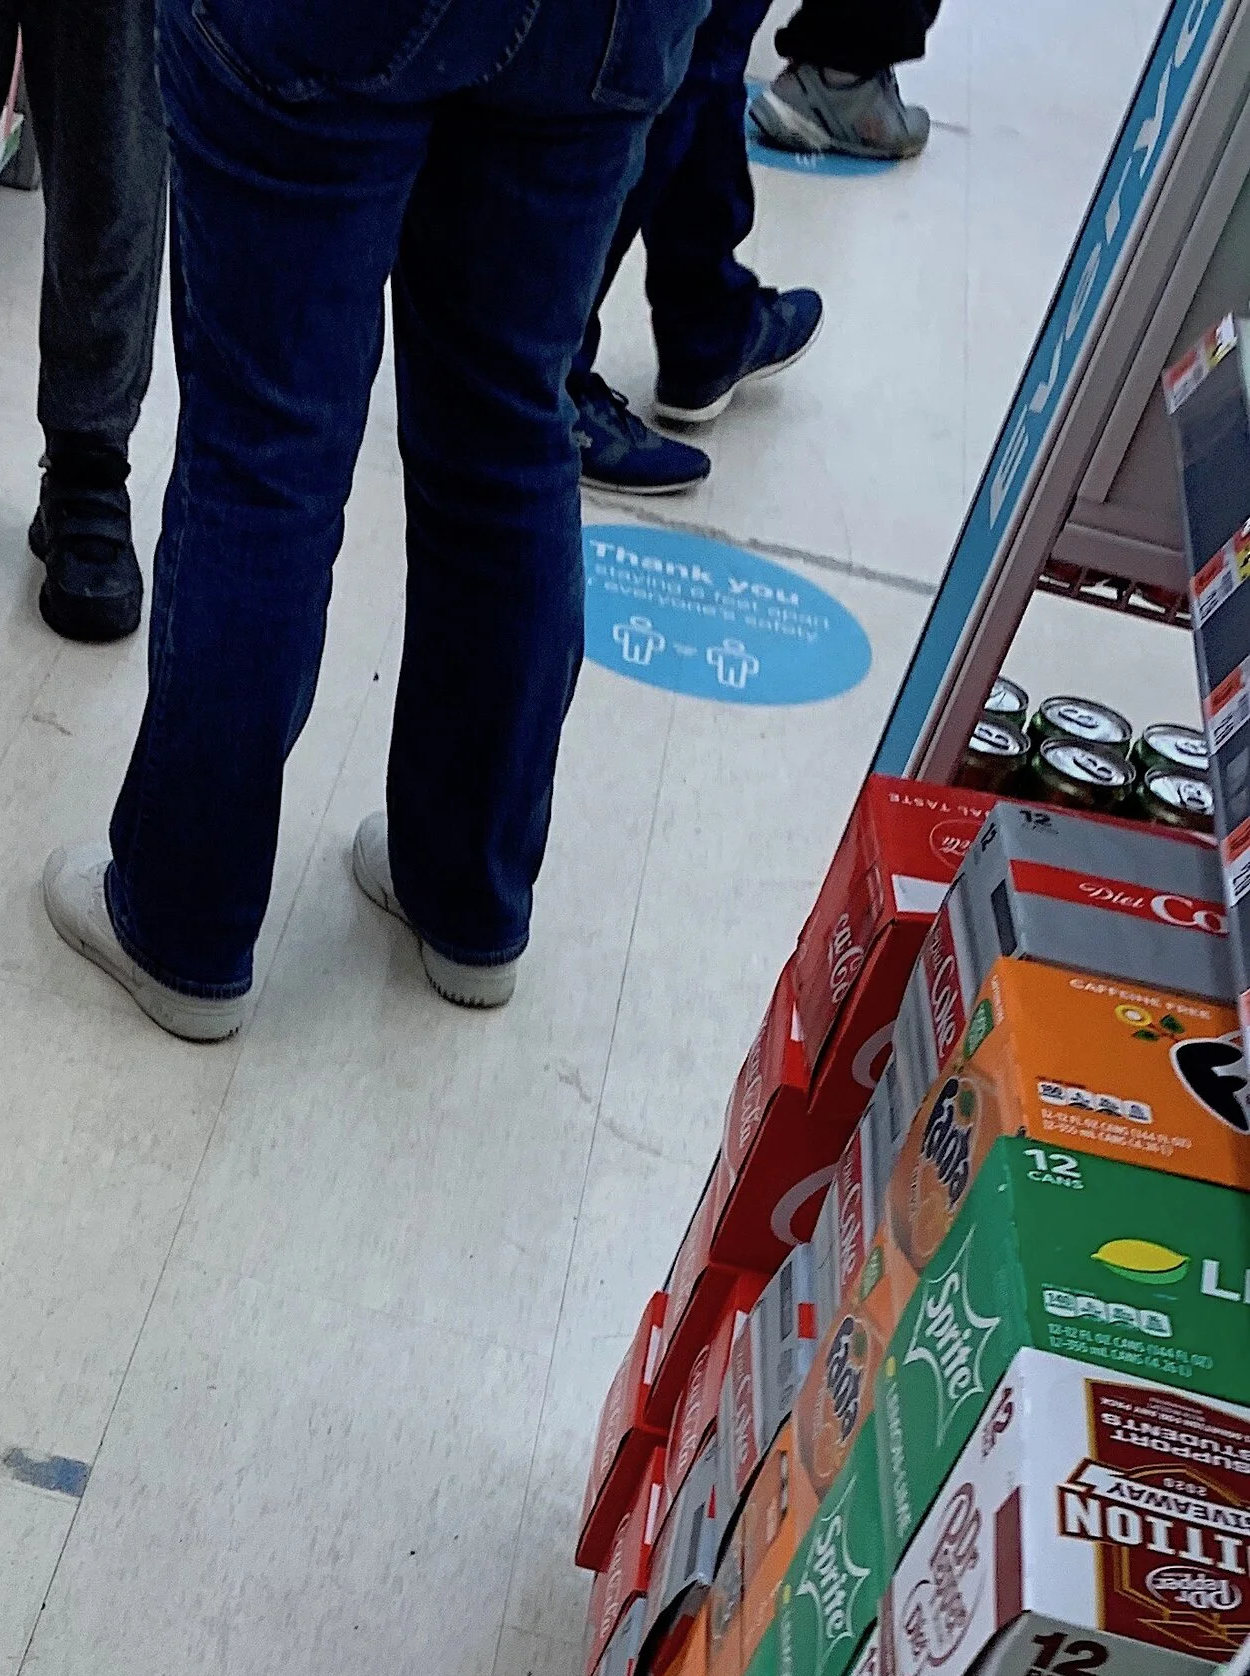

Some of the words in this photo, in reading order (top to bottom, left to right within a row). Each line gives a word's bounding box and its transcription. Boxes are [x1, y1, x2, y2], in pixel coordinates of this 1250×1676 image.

[589, 539, 713, 585] Thank
[727, 576, 801, 607] you
[1078, 882, 1146, 909] Diet
[1023, 1148, 1083, 1179] 12
[1026, 1169, 1085, 1190] CANS
[925, 1272, 974, 1400] Sprite
[1101, 1412, 1250, 1461] STUDENTS
[1110, 1429, 1250, 1474] SUPPORT
[1064, 1491, 1250, 1576] ITION
[814, 1514, 849, 1639] Sprite
